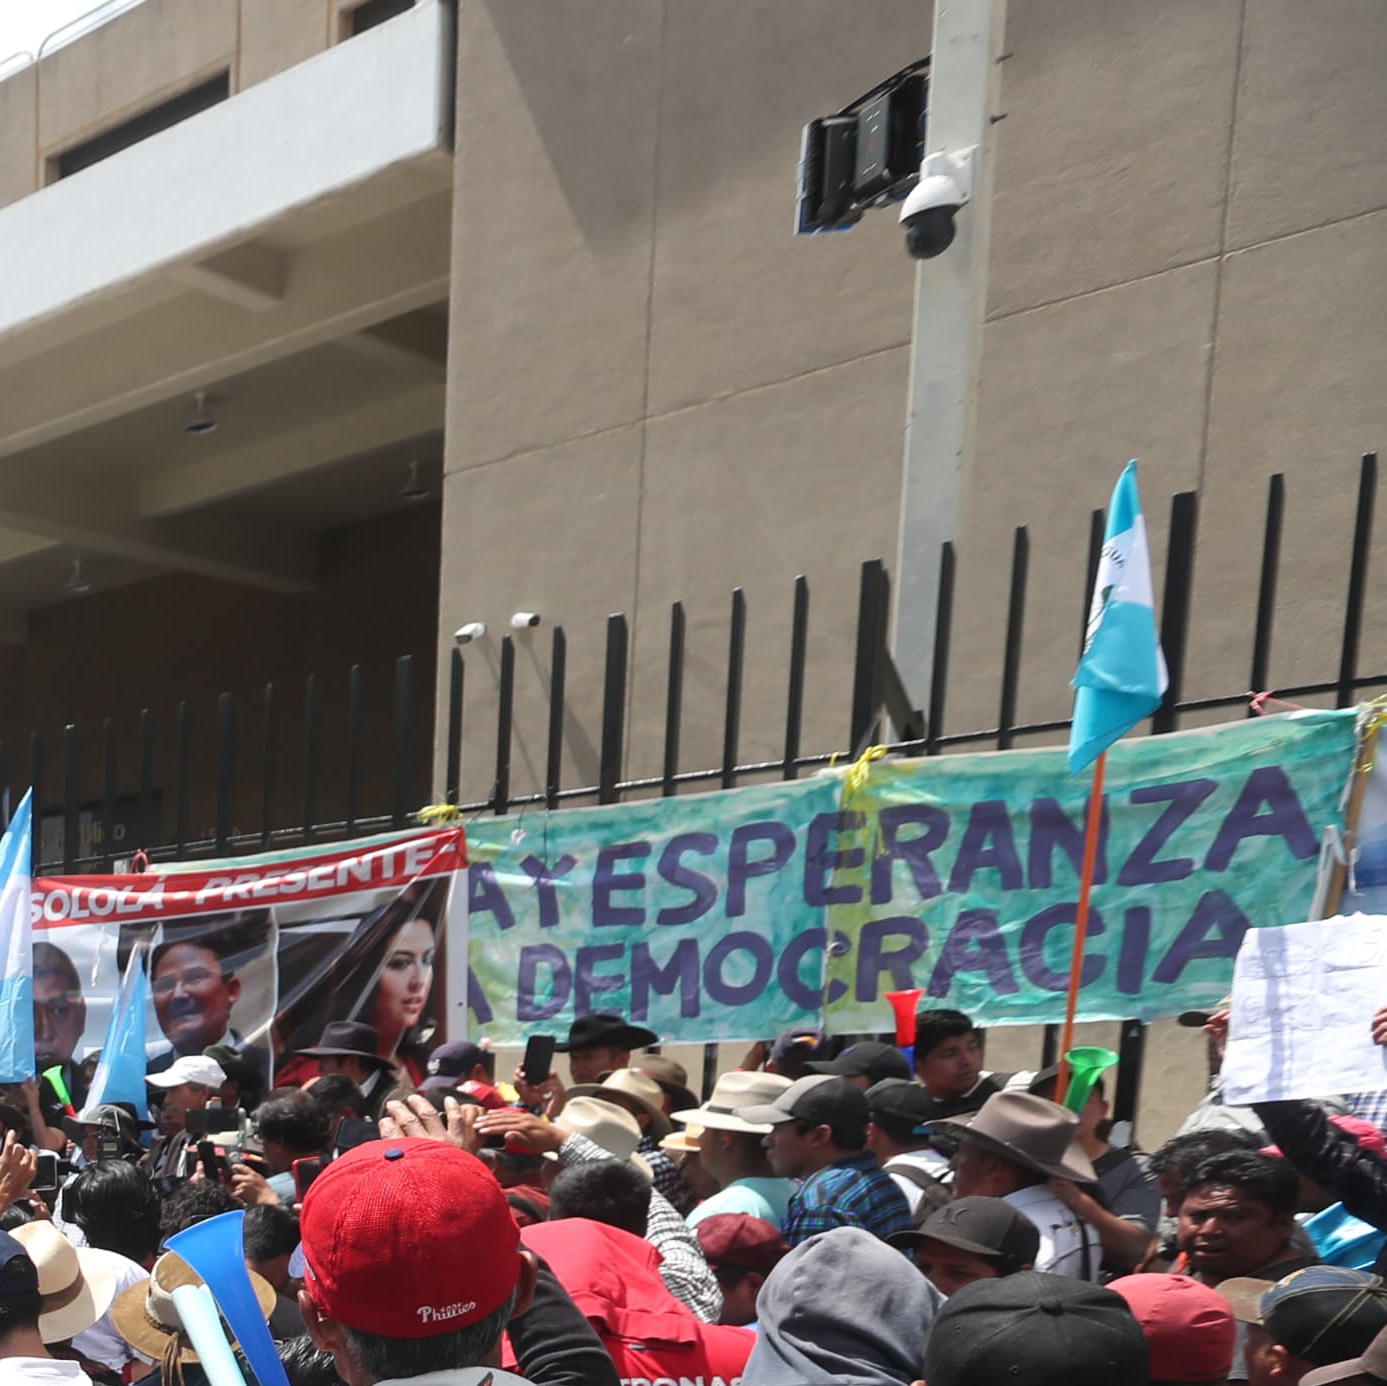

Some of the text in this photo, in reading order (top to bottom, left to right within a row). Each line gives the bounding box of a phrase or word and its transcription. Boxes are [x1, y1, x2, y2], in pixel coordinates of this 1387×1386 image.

[195, 839, 437, 906] PRESENTE
[516, 888, 1252, 1022] DEMOCRACIA
[416, 1300, 476, 1324] Phillies
